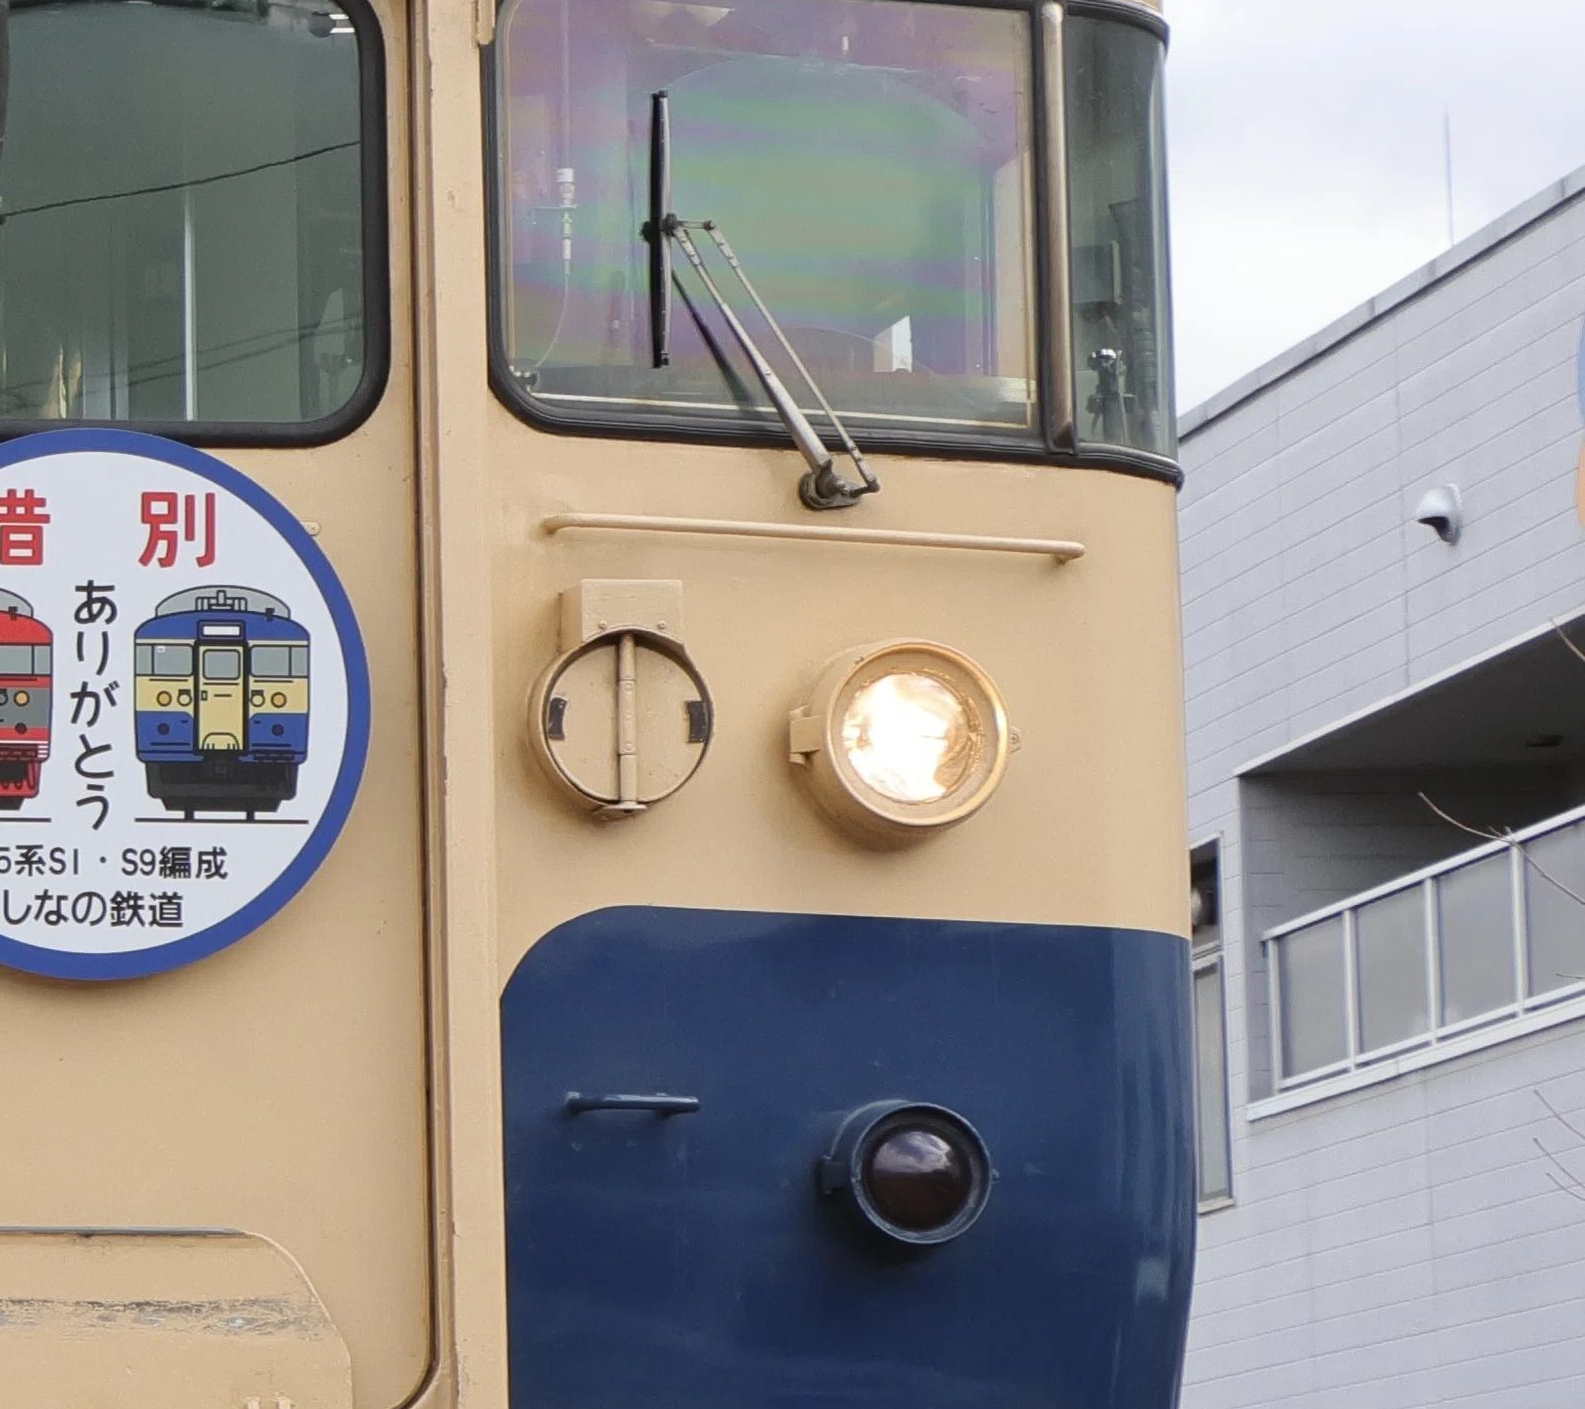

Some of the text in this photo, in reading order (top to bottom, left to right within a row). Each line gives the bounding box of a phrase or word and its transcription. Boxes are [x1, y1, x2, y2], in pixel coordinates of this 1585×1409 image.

[69, 579, 120, 832] ありがとう
[1, 888, 184, 929] しなの鉄道
